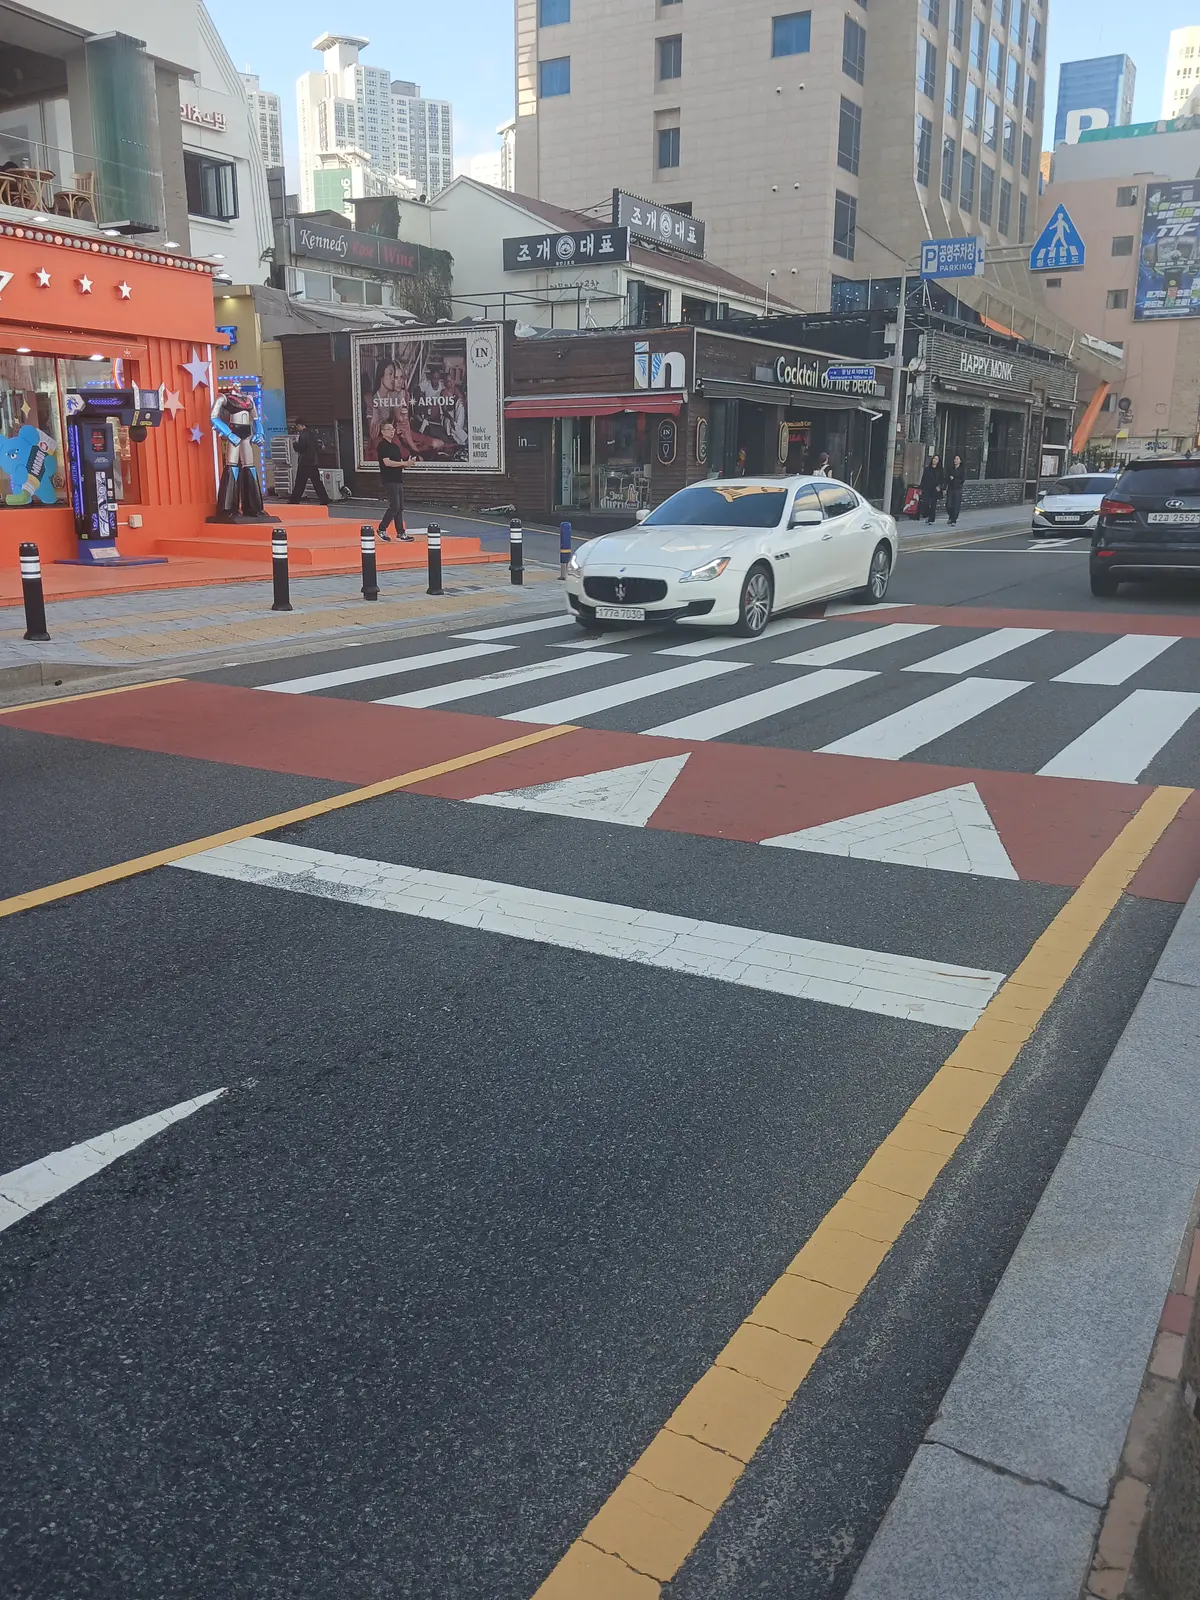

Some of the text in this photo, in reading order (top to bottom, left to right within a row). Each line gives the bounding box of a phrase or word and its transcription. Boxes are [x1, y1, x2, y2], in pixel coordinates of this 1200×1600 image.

[631, 206, 657, 233] 조개
[674, 220, 697, 244] 대표
[300, 229, 348, 258] Kennedy
[384, 245, 414, 268] Wine
[517, 233, 615, 262] 조개 대표
[940, 242, 975, 263] 공영주차장
[925, 248, 936, 270] P
[940, 263, 973, 272] PARKING
[476, 348, 488, 358] IN
[219, 360, 239, 370] 5101
[634, 341, 686, 389] in
[777, 356, 819, 387] Cocktail
[960, 352, 1013, 381] HAPPY MONK
[373, 396, 455, 408] STELLA ARTOIS
[481, 442, 490, 450] LIFE
[518, 436, 528, 447] in
[1173, 513, 1196, 522] 2552
[620, 609, 641, 620] 7030
